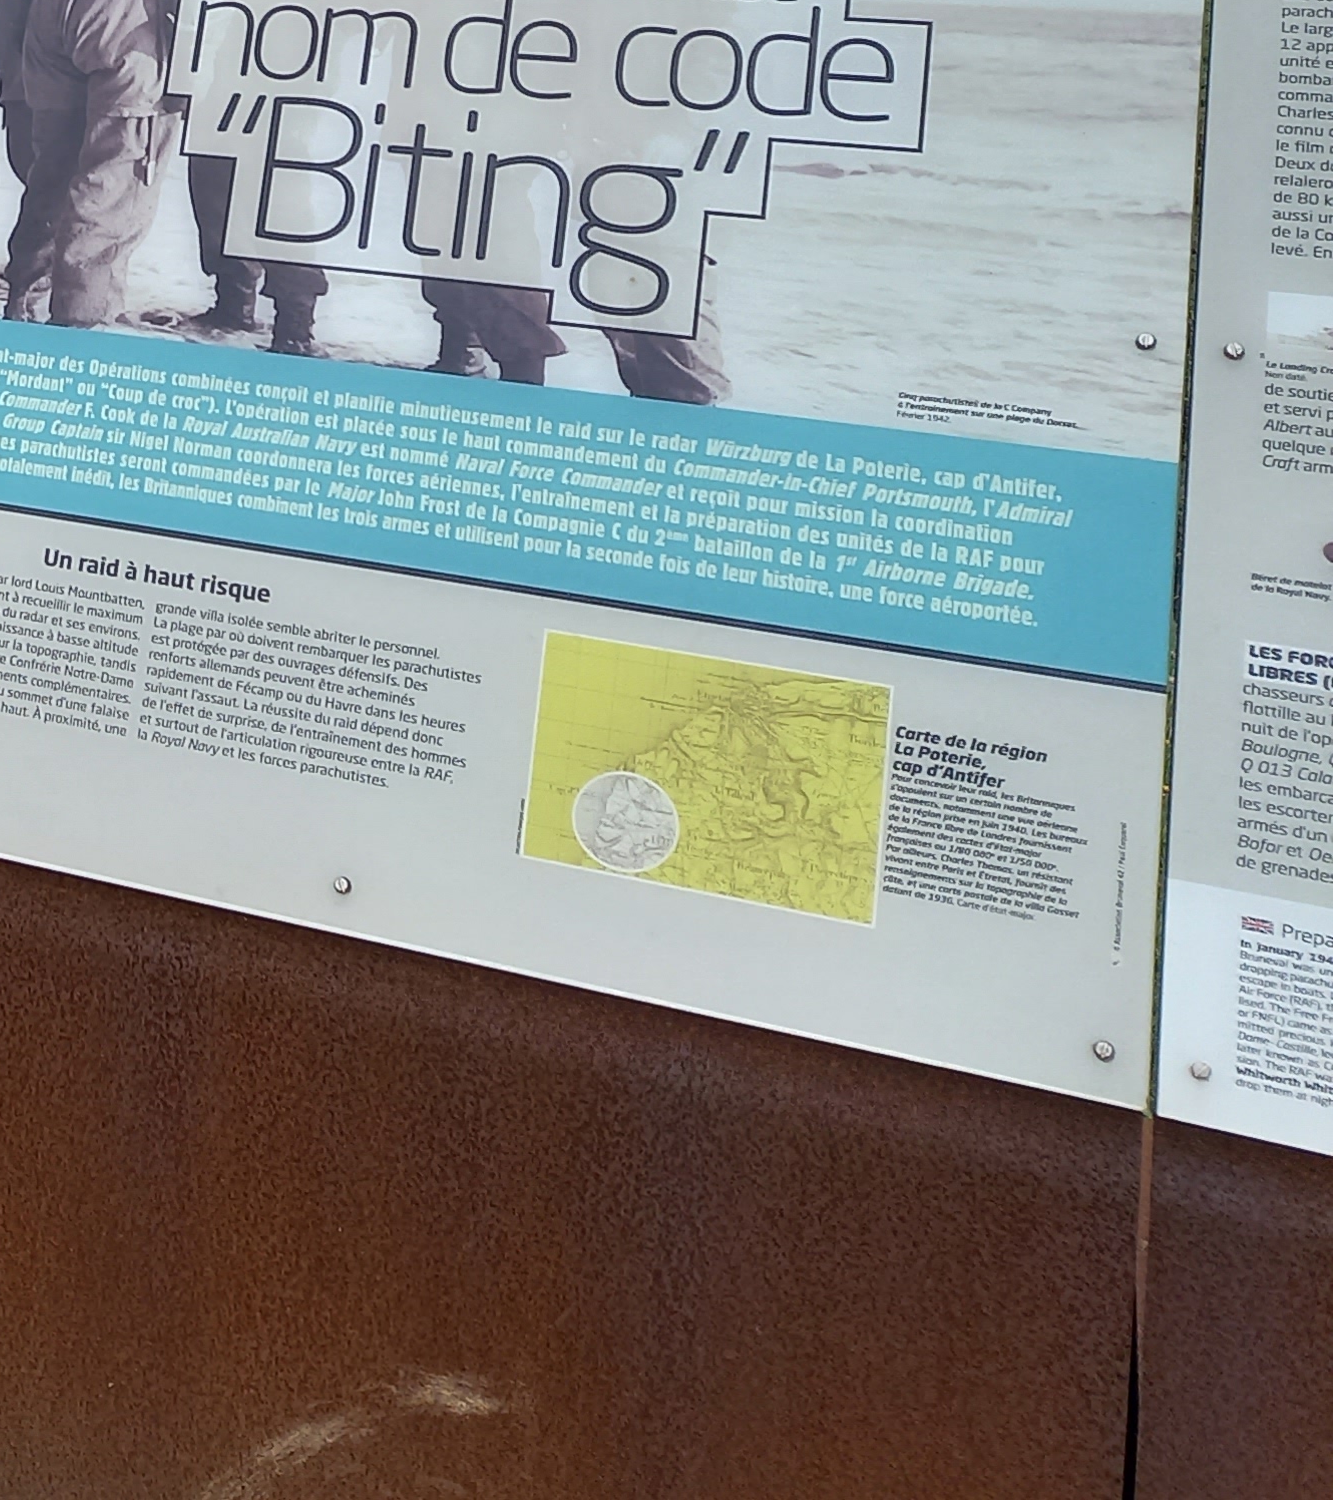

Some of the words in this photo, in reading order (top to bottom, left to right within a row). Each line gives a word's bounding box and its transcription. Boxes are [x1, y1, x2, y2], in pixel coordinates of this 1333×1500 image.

[1281, 21, 1299, 33] Le
[1280, 38, 1302, 50] 12
[191, 0, 418, 88] nom
[615, 5, 895, 122] code
[1279, 54, 1320, 68] unité
[1276, 124, 1324, 137] connu
[1275, 139, 1290, 152] le
[1295, 140, 1324, 154] film
[1275, 156, 1316, 171] Deux
[218, 92, 751, 316] "Biting"
[1273, 191, 1293, 204] de
[1297, 192, 1319, 206] 80
[1272, 209, 1313, 223] aussi
[1271, 225, 1291, 238] de
[1296, 227, 1310, 240] la
[1271, 243, 1308, 257] levé.
[1264, 383, 1283, 396] de
[1263, 402, 1281, 414] et
[1284, 404, 1322, 419] servi
[59, 355, 85, 374] des
[89, 359, 167, 384] Opérations
[171, 373, 251, 395] combinées
[255, 384, 309, 404] conçoit
[313, 389, 330, 406] et
[333, 392, 395, 414] planifie
[399, 401, 531, 431] minutieusement
[536, 416, 553, 435] le
[558, 421, 592, 440] raid
[596, 427, 624, 444] sur
[629, 428, 646, 447] le
[651, 434, 698, 453] radar
[706, 439, 792, 467] Würzburg
[796, 450, 819, 470] de
[825, 453, 846, 473] La
[852, 457, 927, 485] Poterie,
[934, 471, 965, 489] cap
[972, 473, 1062, 502] d'Antifer,
[1263, 419, 1313, 437] Albert
[1315, 425, 1333, 438] au
[77, 382, 96, 397] ou
[147, 388, 167, 406] de
[225, 398, 310, 425] L'opération
[314, 413, 339, 430] est
[342, 415, 395, 437] placée
[399, 425, 438, 443] sous
[441, 427, 458, 446] le
[463, 430, 500, 452] haut
[506, 440, 638, 470] commandement
[644, 454, 666, 474] du
[674, 459, 857, 498] Commander-in-Chief
[862, 483, 977, 516] Portsmouth,
[1262, 438, 1325, 456] quelque
[1262, 454, 1300, 473] Craft
[43, 547, 73, 570] Un
[78, 556, 120, 578] raid
[124, 560, 138, 581] à
[143, 564, 196, 591] haut
[200, 574, 271, 603] risque
[10, 575, 33, 590] lord
[34, 579, 66, 596] Louis
[67, 585, 145, 610] Mountbatten,
[1248, 645, 1283, 661] LES
[1248, 663, 1317, 685] LIBRES
[1242, 682, 1325, 707] chasseurs
[1243, 700, 1301, 722] flottille
[1305, 712, 1326, 726] au
[1241, 721, 1274, 738] nuit
[1277, 726, 1298, 741] de
[895, 725, 941, 745] Carte
[944, 734, 967, 750] de
[969, 737, 988, 753] la
[990, 743, 1048, 763] région
[1241, 738, 1323, 766] Boulogne,
[894, 741, 915, 757] La
[917, 745, 986, 770] Poterie,
[892, 760, 923, 775] cap
[926, 764, 1006, 788] d'Antifer
[1240, 757, 1253, 773] Q
[1258, 760, 1293, 778] 013
[1239, 777, 1263, 793] les
[1238, 796, 1262, 812] les
[1237, 817, 1288, 836] armés
[1292, 824, 1328, 843] d'un
[1237, 834, 1283, 856] Bofor
[1286, 846, 1303, 859] et
[1236, 854, 1257, 870] de
